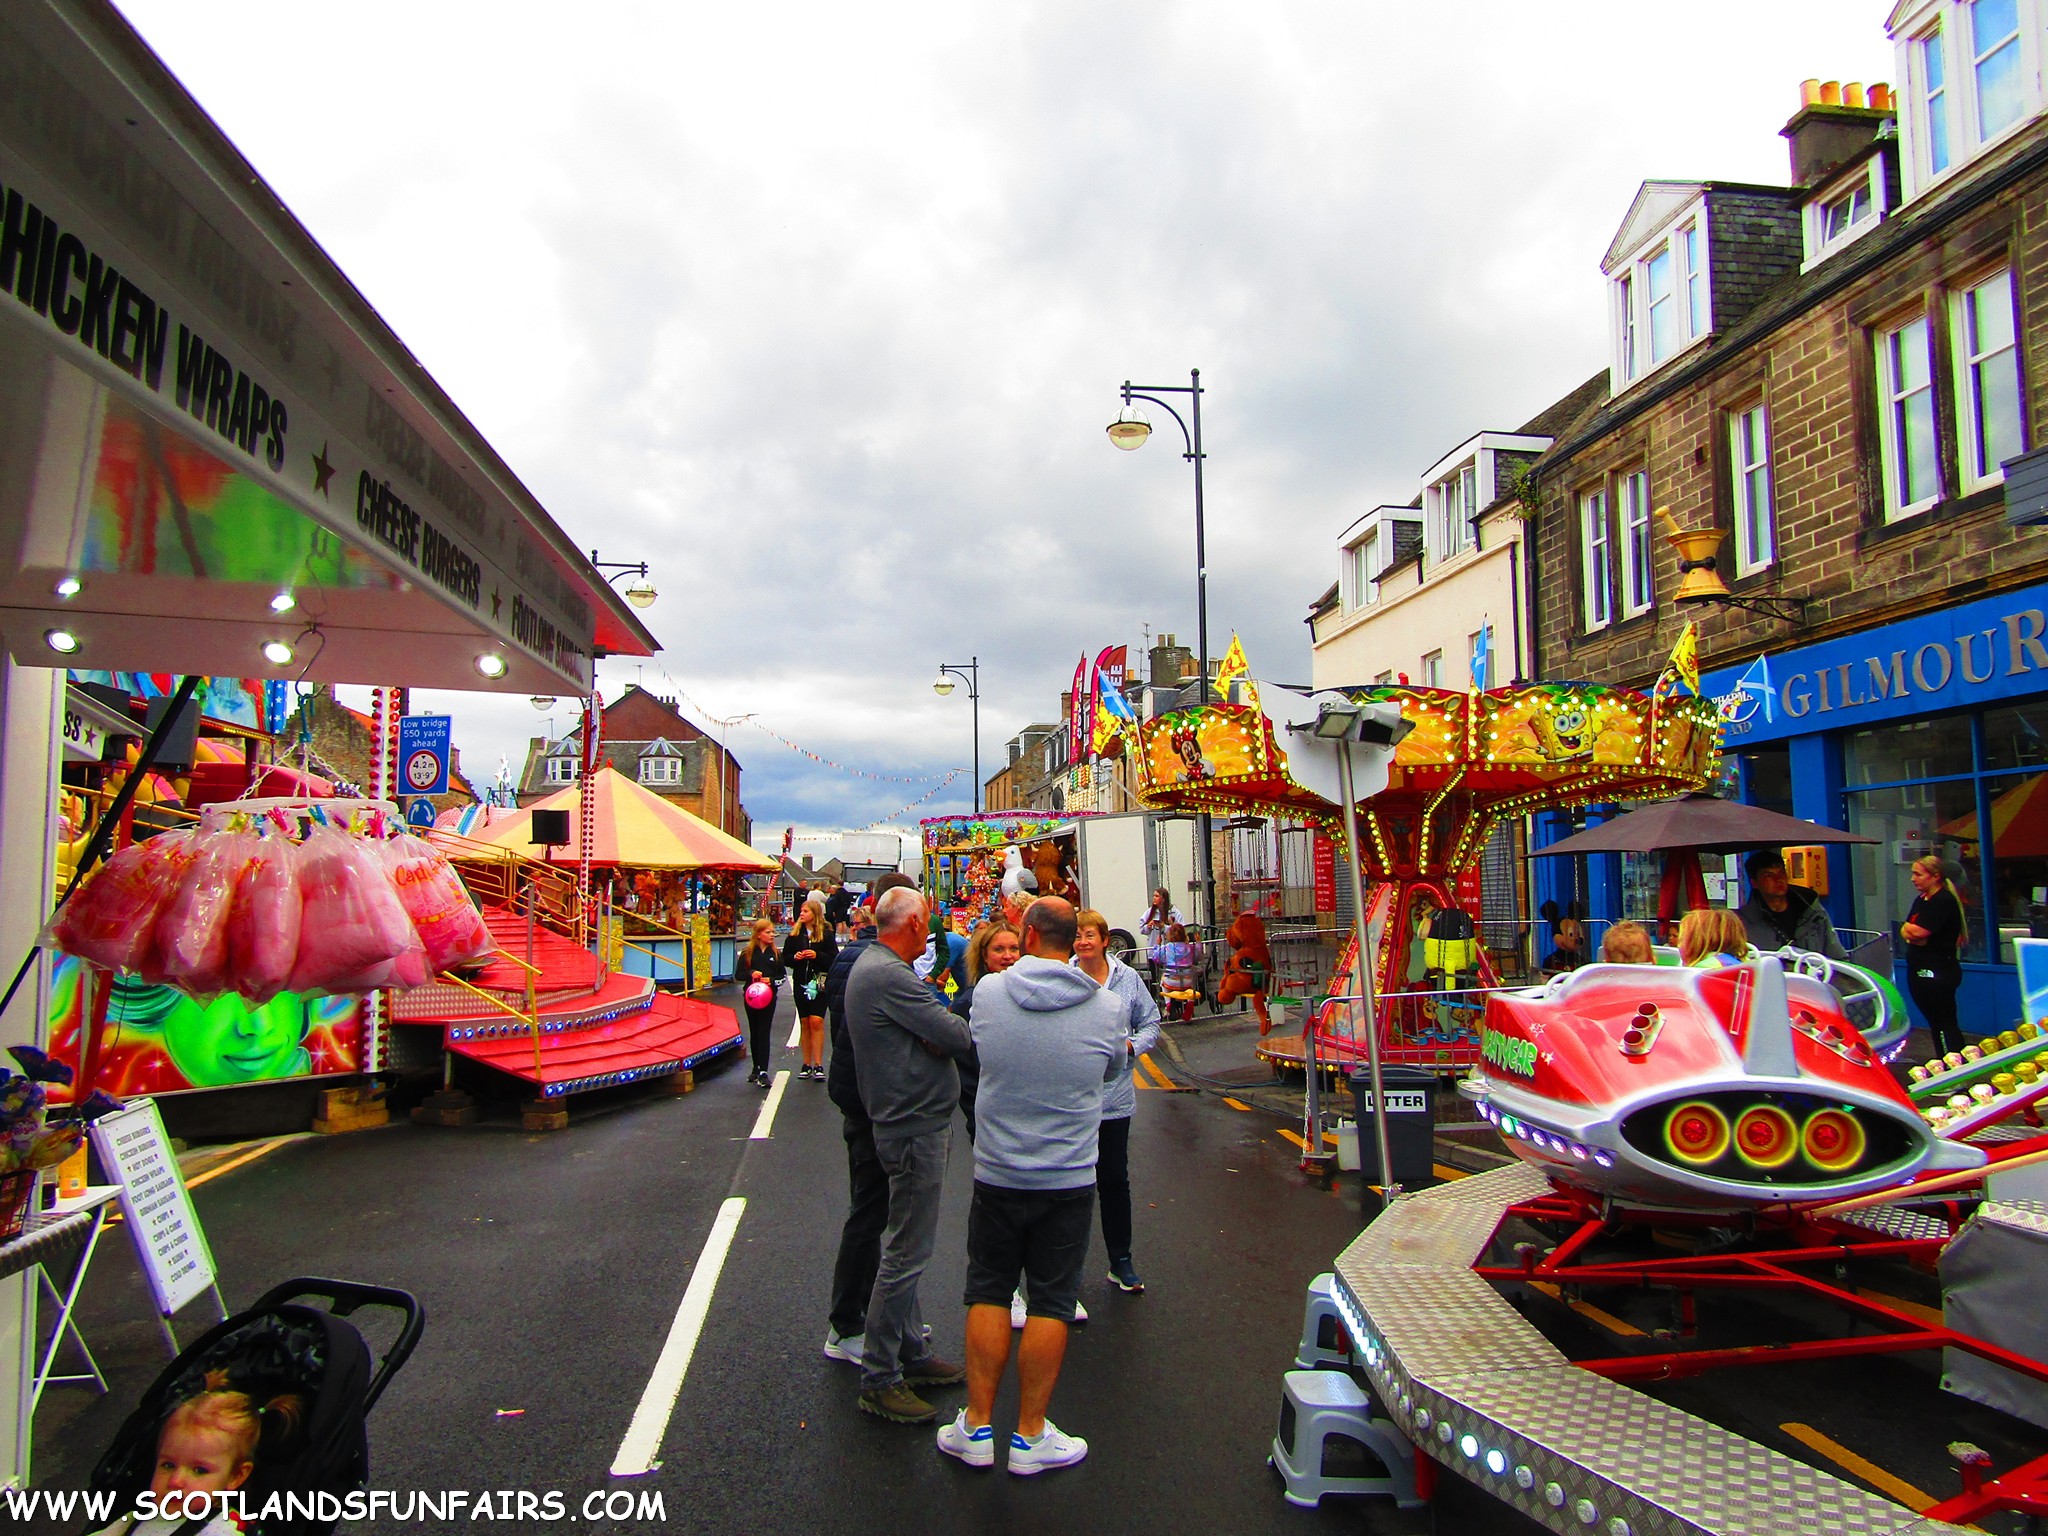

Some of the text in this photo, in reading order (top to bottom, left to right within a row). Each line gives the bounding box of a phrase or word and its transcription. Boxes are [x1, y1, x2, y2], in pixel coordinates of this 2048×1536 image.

[0, 181, 168, 394] HICKEN
[176, 322, 288, 474] WRAPS
[357, 469, 421, 568] CHEESE
[422, 521, 481, 611] BURGERS
[1781, 608, 2048, 719] GILMOUR
[403, 719, 448, 729] Low bridge
[404, 729, 446, 739] 550 yards
[412, 739, 437, 748] ahead
[1367, 1095, 1425, 1107] LTTER
